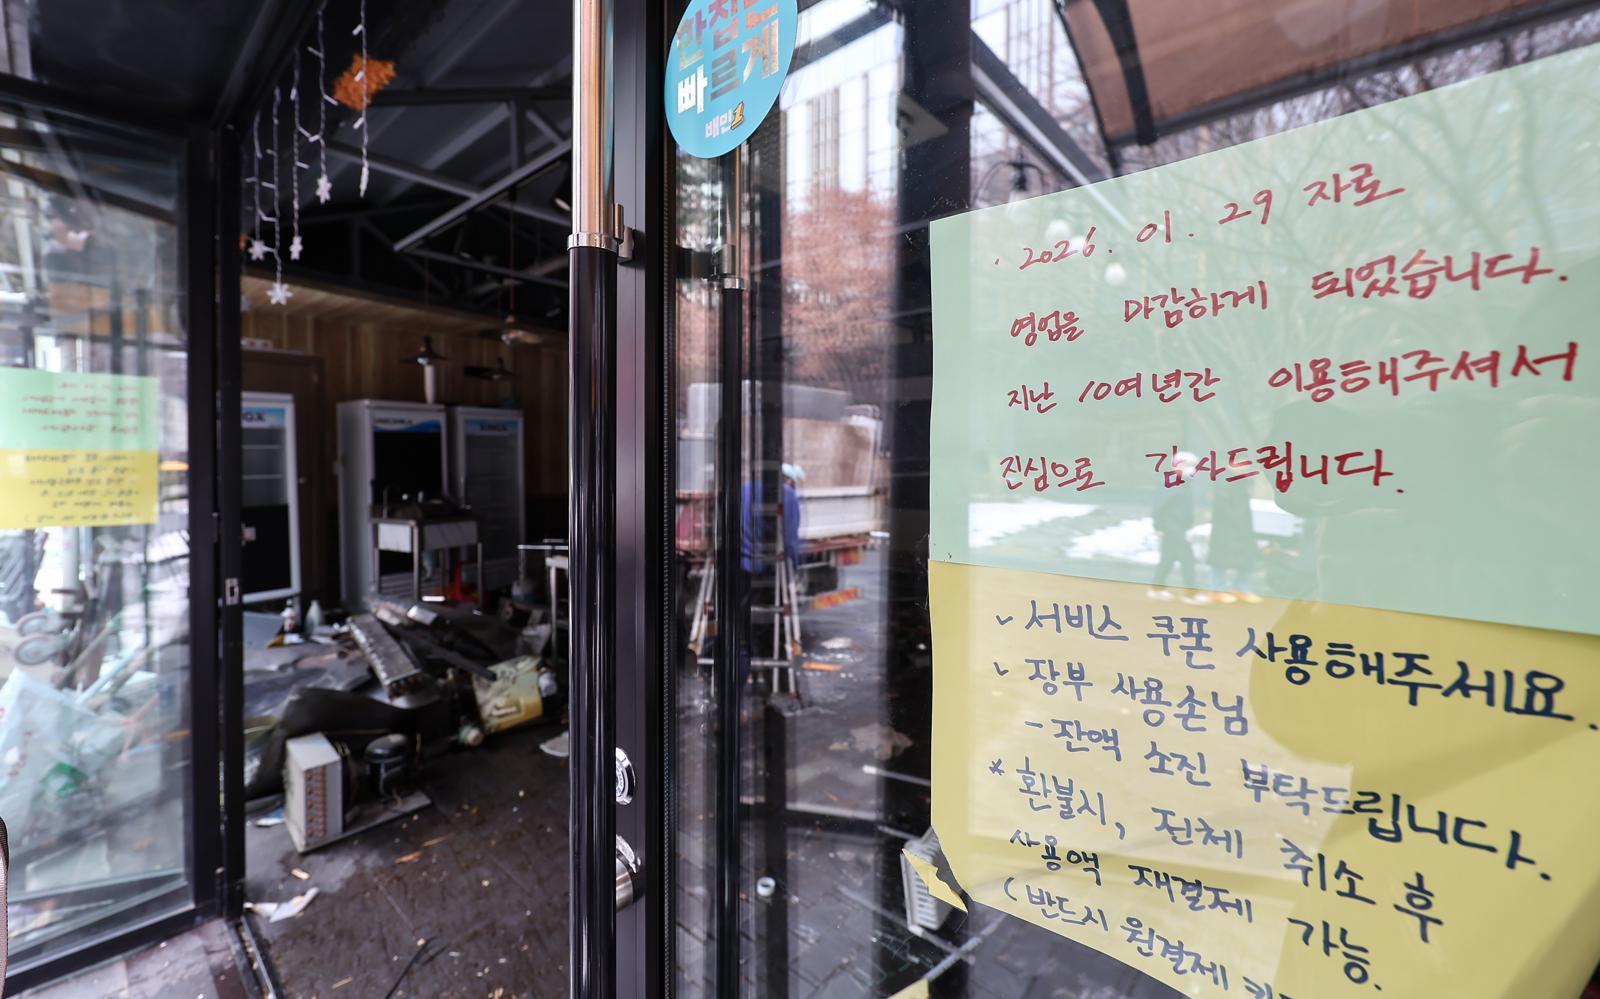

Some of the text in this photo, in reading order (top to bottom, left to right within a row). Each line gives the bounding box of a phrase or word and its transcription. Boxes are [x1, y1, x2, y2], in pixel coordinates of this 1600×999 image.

[676, 19, 780, 114] 빠르게
[705, 101, 745, 138] 배민1
[1218, 188, 1273, 225] 29
[1303, 162, 1406, 207] 자로
[1010, 246, 1569, 347] 영업을 마감하게 되었습니다.
[1007, 383, 1058, 415] 지난
[1266, 341, 1580, 404] 이용해주셔서
[999, 441, 1406, 495] 진심으로 감사드립니다.
[1024, 599, 1599, 731] 서비스 쿠폰 사용해주세요.
[1024, 658, 1094, 702] 장부
[1050, 718, 1553, 882] 잔액 소진 부탁드립니다.
[1017, 757, 1445, 944] 환불시, 전체 취소 후
[1009, 829, 1383, 992] 사용액 재결제 가능.
[1120, 916, 1229, 992] 원결제
